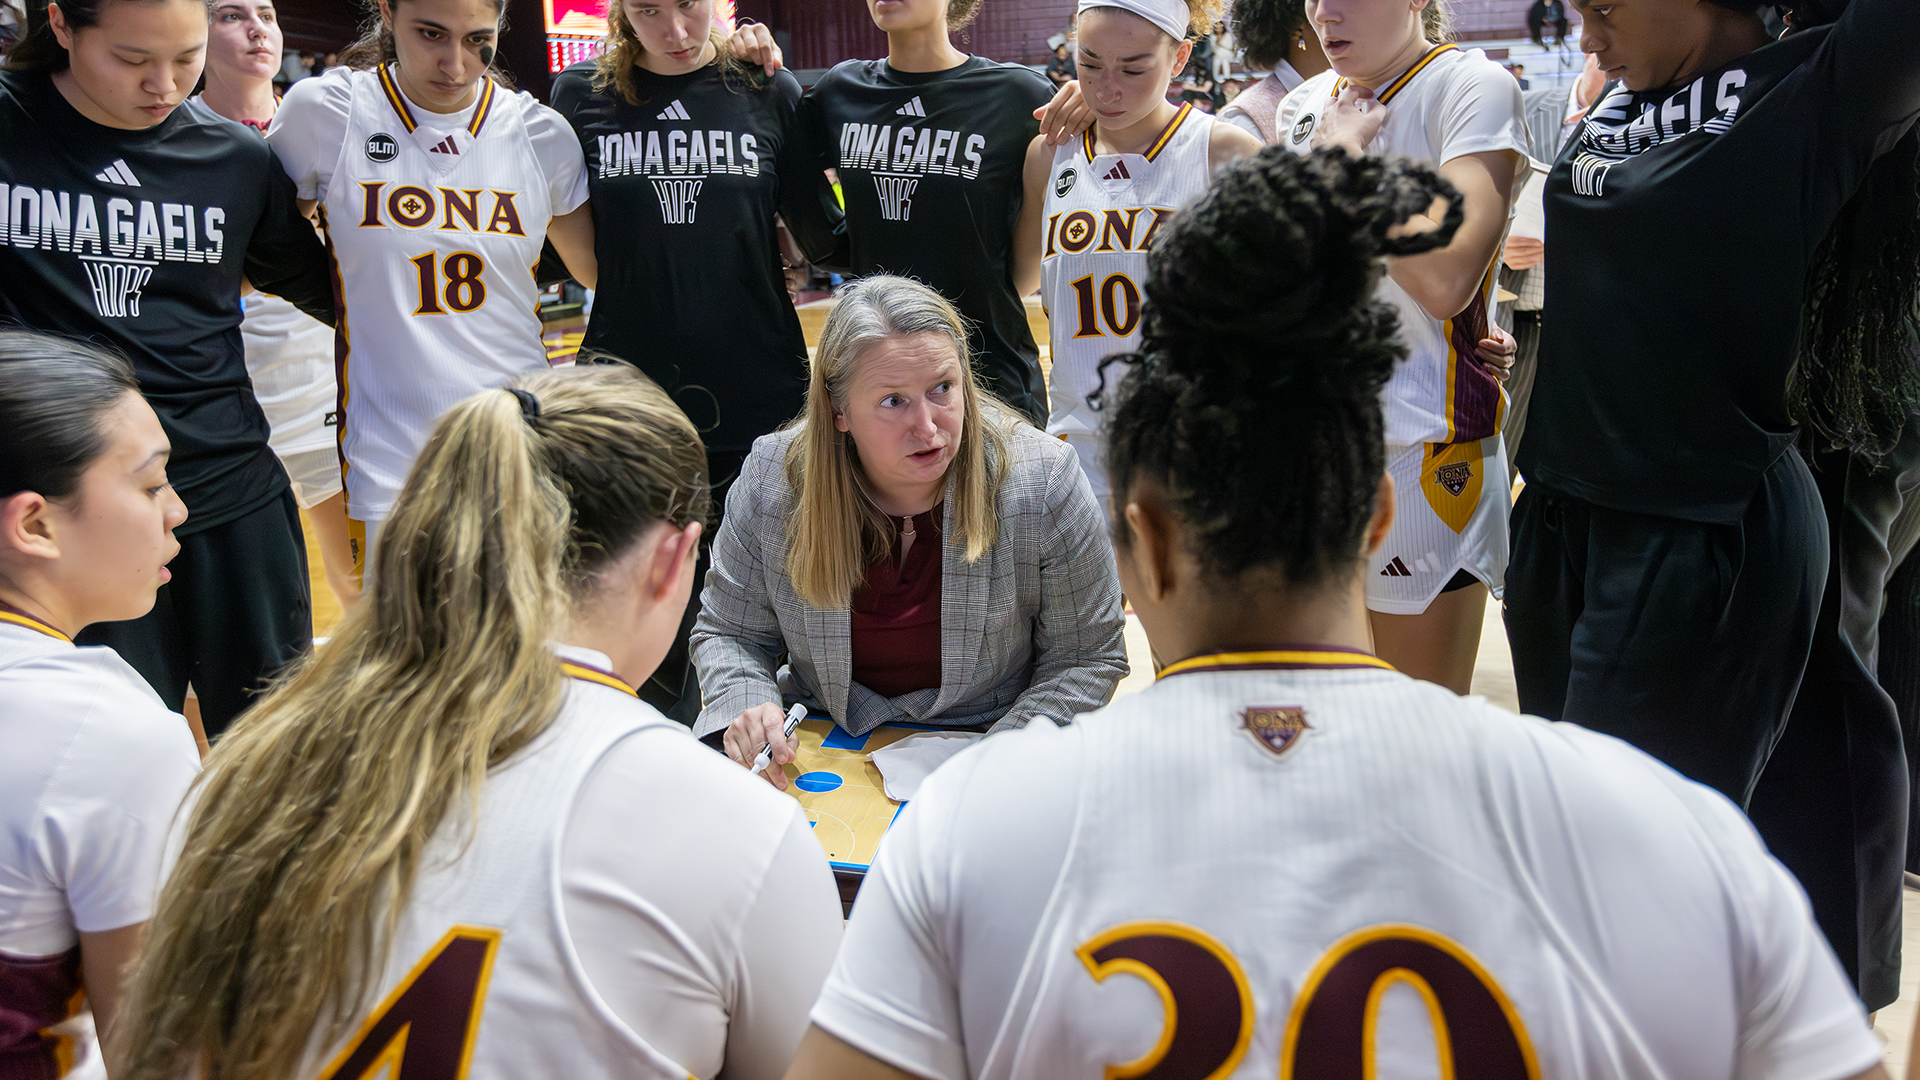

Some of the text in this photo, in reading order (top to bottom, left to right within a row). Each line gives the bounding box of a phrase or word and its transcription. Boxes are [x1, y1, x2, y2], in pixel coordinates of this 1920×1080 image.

[368, 141, 396, 156] BLM
[598, 130, 759, 179] IONA GAELS
[840, 123, 986, 180] IONA GAELS
[358, 181, 528, 238] IONA
[651, 180, 703, 224] HOOPS
[873, 176, 918, 221] HOOPS
[1057, 175, 1076, 191] BLM
[0, 181, 225, 264] IONA GAELS
[83, 261, 153, 317] HOOPS
[409, 250, 488, 317] 18
[1069, 272, 1142, 339] 10
